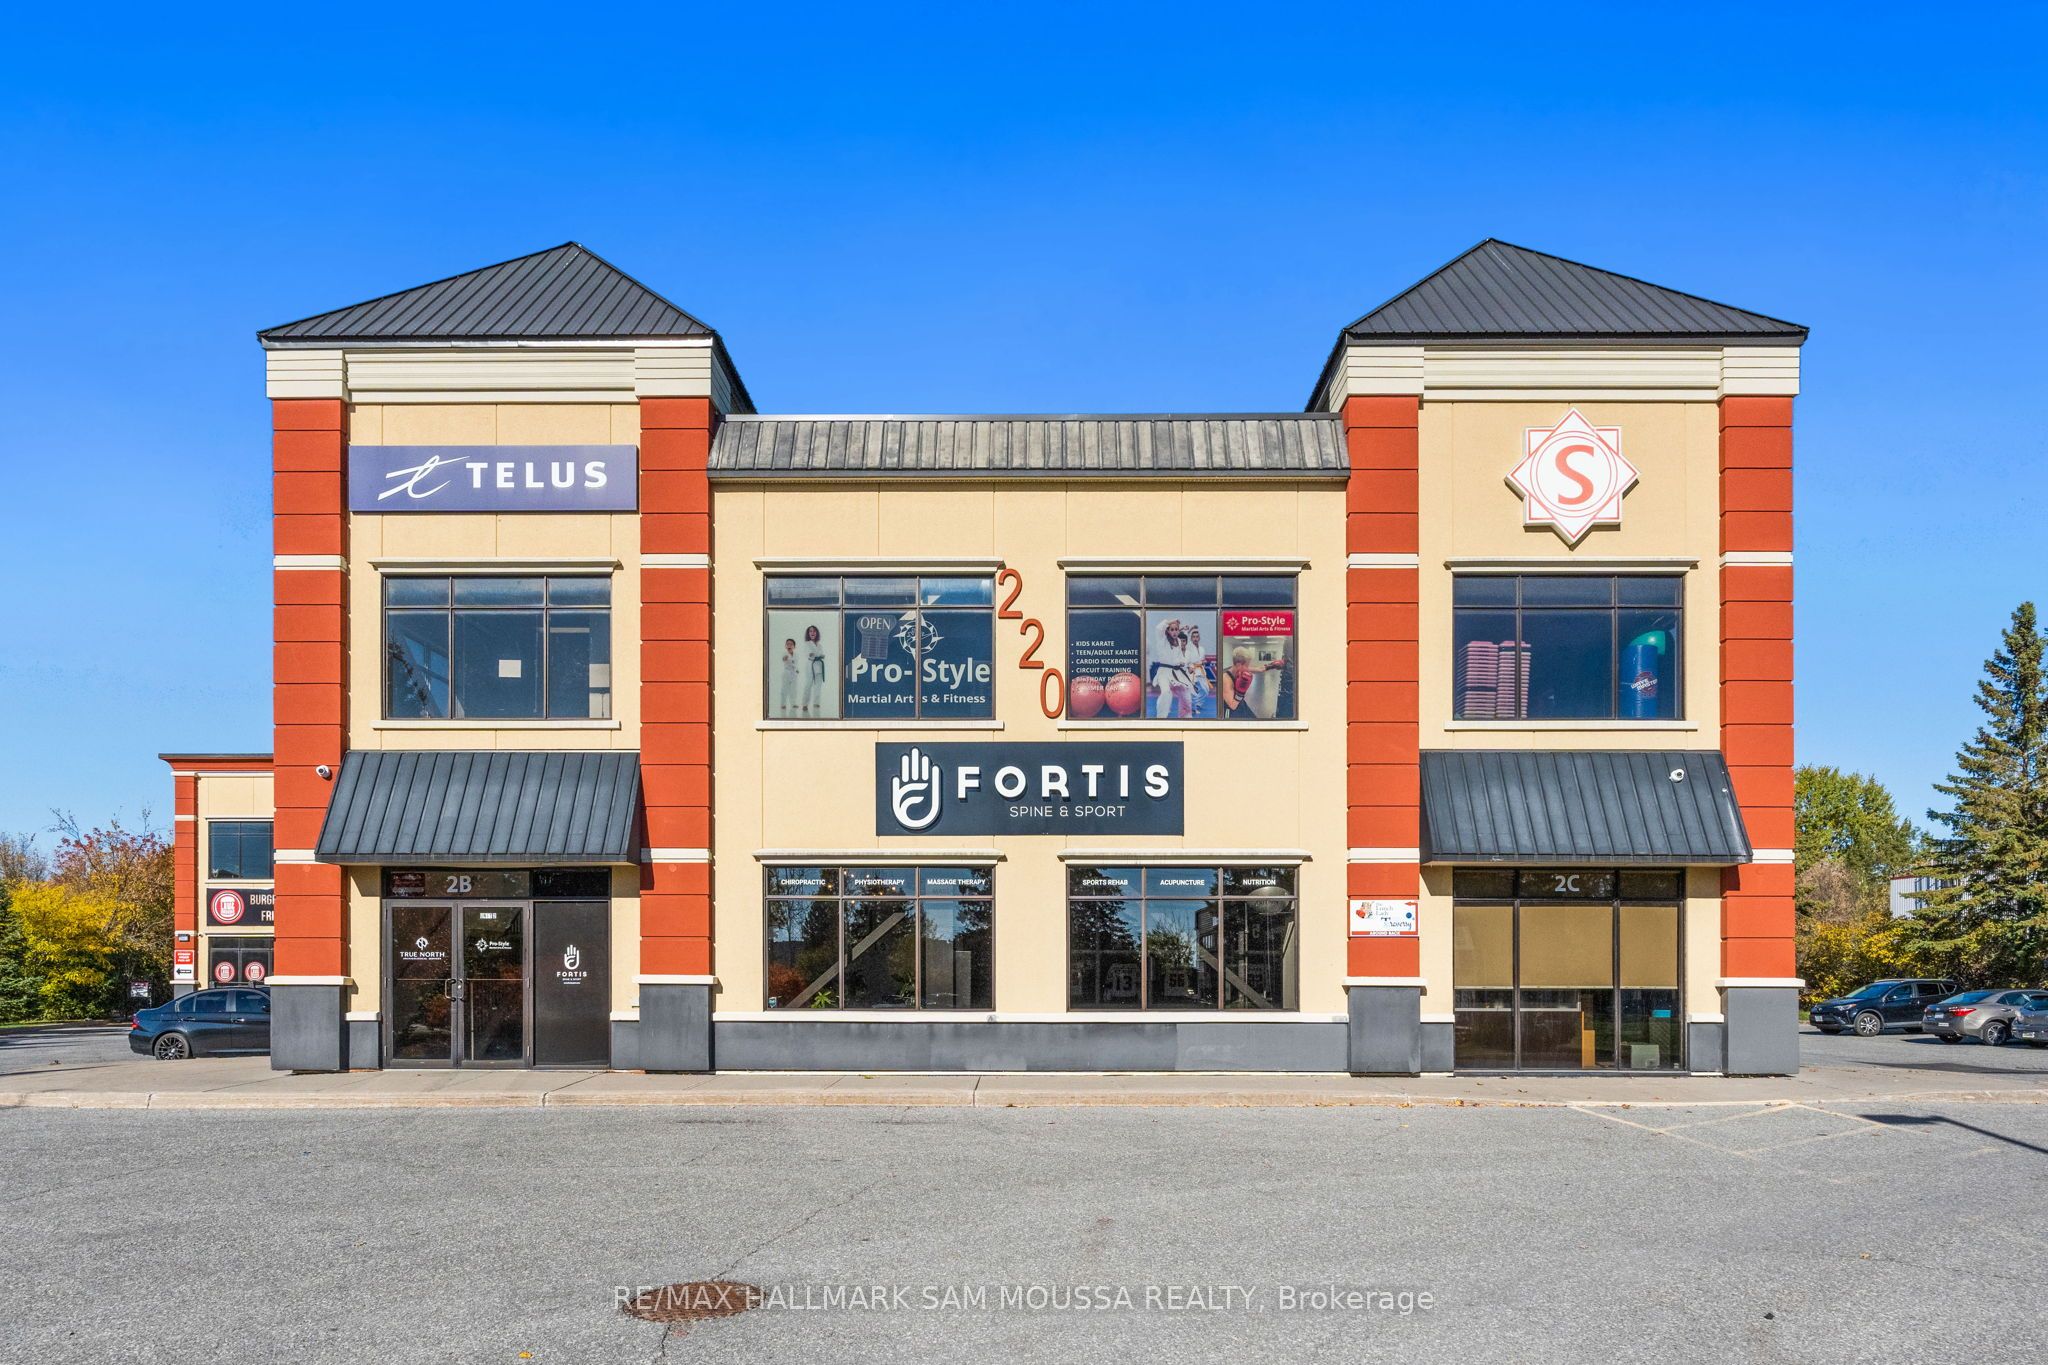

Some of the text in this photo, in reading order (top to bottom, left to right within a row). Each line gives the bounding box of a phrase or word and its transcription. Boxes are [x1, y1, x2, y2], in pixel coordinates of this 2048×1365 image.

[466, 461, 608, 488] TELUS
[1555, 444, 1595, 505] S
[860, 616, 891, 630] OPEN
[1242, 615, 1286, 627] Pro-Style
[848, 694, 891, 703] Martial
[931, 694, 940, 703] &
[943, 694, 986, 703] Fitness
[957, 764, 1170, 799] FORTIS
[1009, 806, 1126, 817] SPINE & SPORT
[446, 875, 472, 893] 2B
[1555, 874, 1580, 892] 2C
